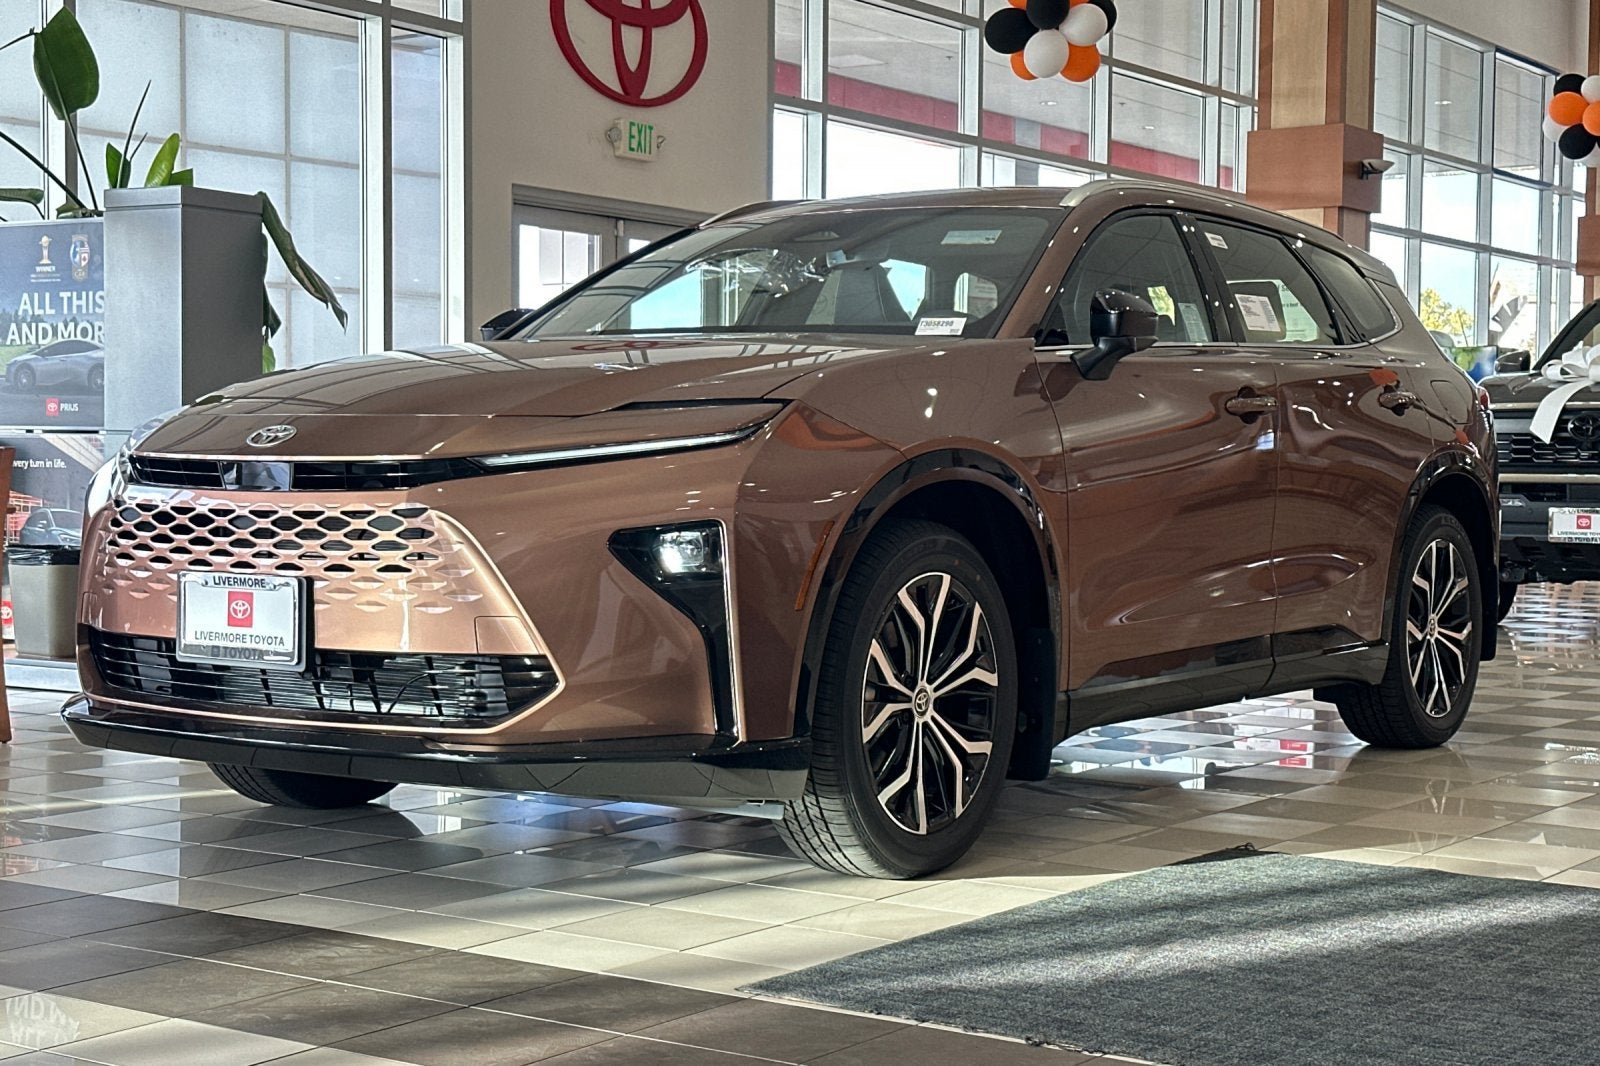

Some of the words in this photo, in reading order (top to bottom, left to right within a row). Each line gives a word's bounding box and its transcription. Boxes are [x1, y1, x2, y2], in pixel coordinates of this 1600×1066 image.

[628, 121, 654, 155] EXIT
[18, 292, 55, 315] ALL
[59, 291, 104, 314] THIS
[6, 322, 53, 345] AND
[57, 321, 104, 343] MOR
[60, 403, 79, 412] PRIUS
[12, 459, 29, 470] very
[29, 459, 45, 468] turn
[46, 458, 53, 468] in
[53, 458, 67, 469] life.
[212, 576, 267, 588] LIVERMORE
[194, 630, 247, 643] LIVERMORE
[249, 635, 285, 647] TOYOTA
[223, 647, 265, 660] TOYOTA
